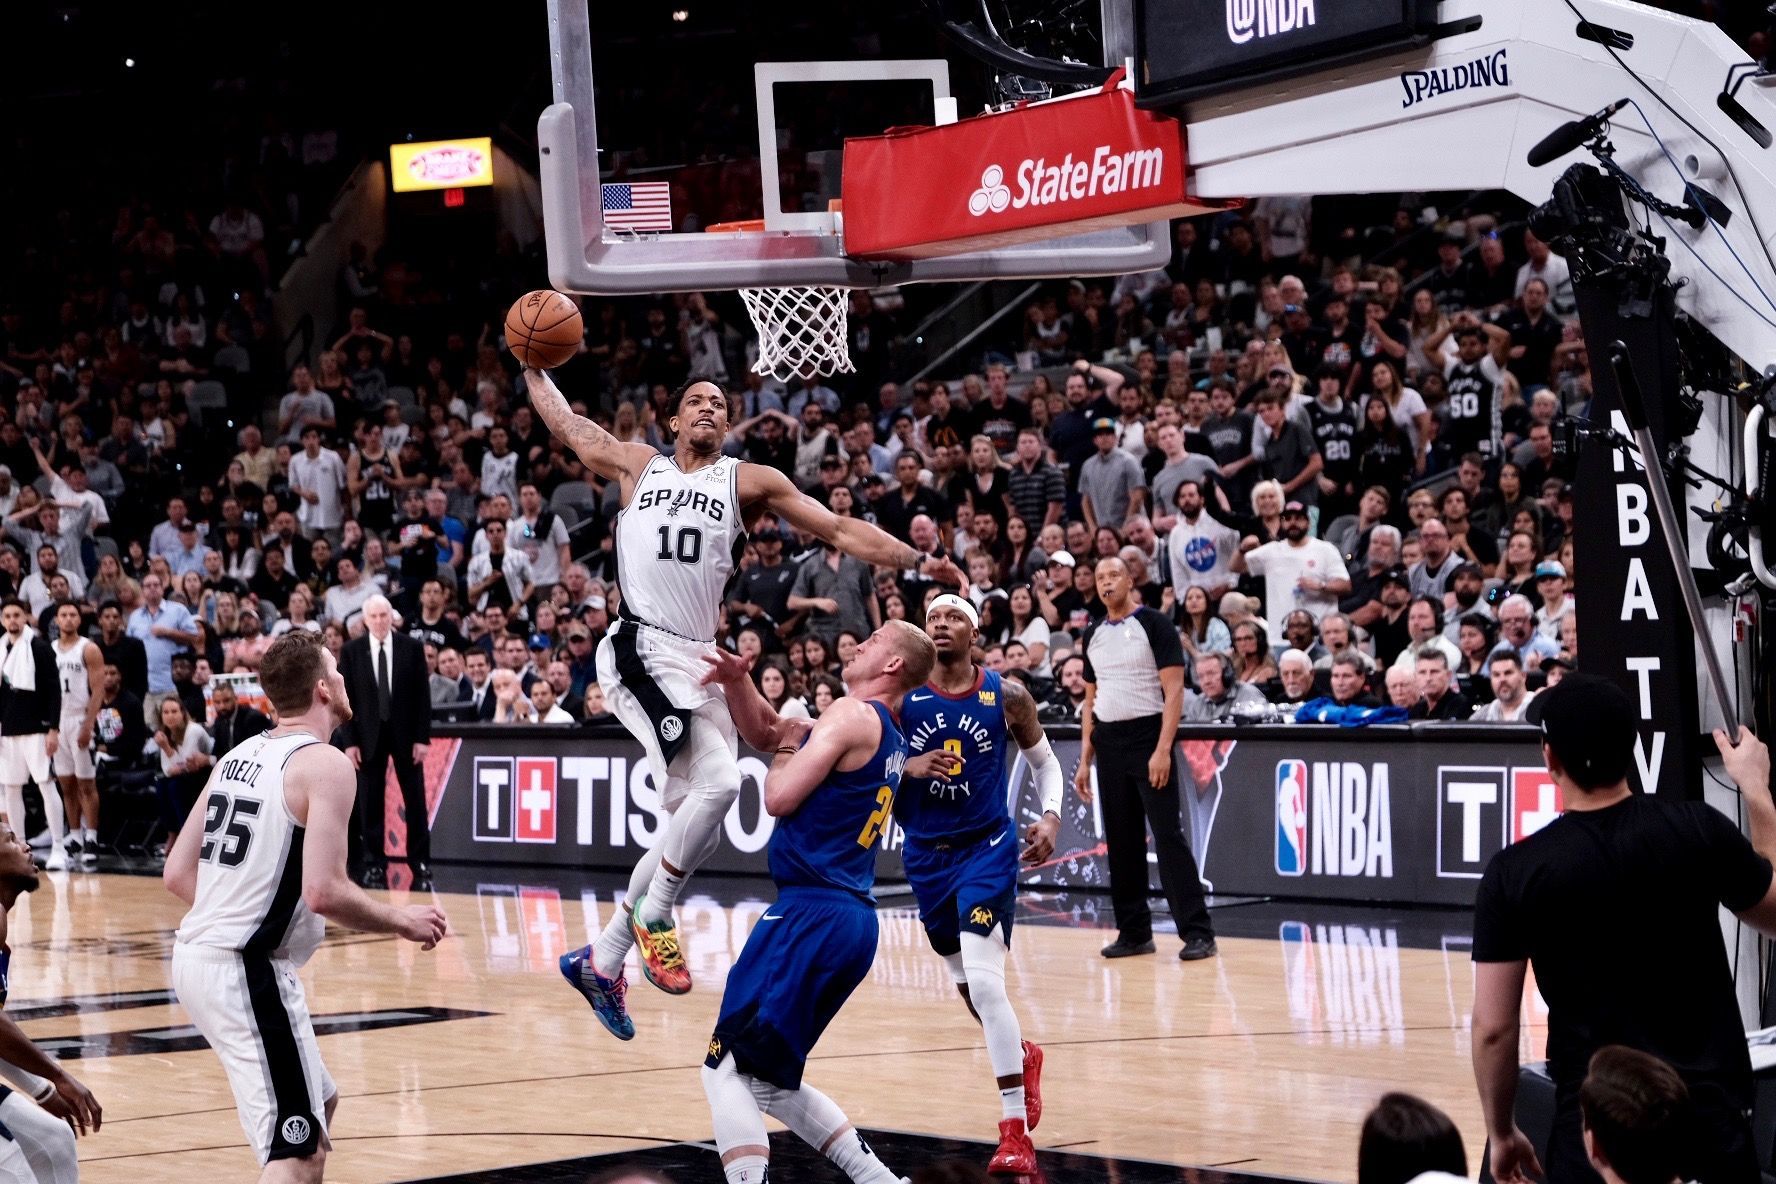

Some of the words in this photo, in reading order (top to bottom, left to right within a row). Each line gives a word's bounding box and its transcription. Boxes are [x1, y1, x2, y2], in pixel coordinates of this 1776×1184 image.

[1400, 48, 1509, 109] SPALDING
[1449, 392, 1479, 419] 50
[1325, 440, 1350, 461] 20
[638, 488, 725, 522] SPURS
[656, 524, 703, 565] 10
[910, 712, 947, 751] MILE
[958, 714, 993, 753] HIGH
[1626, 656, 1666, 794] TV
[561, 756, 776, 853] TISO
[929, 780, 971, 800] CITY
[200, 790, 264, 870] 25
[1311, 762, 1393, 877] NBA
